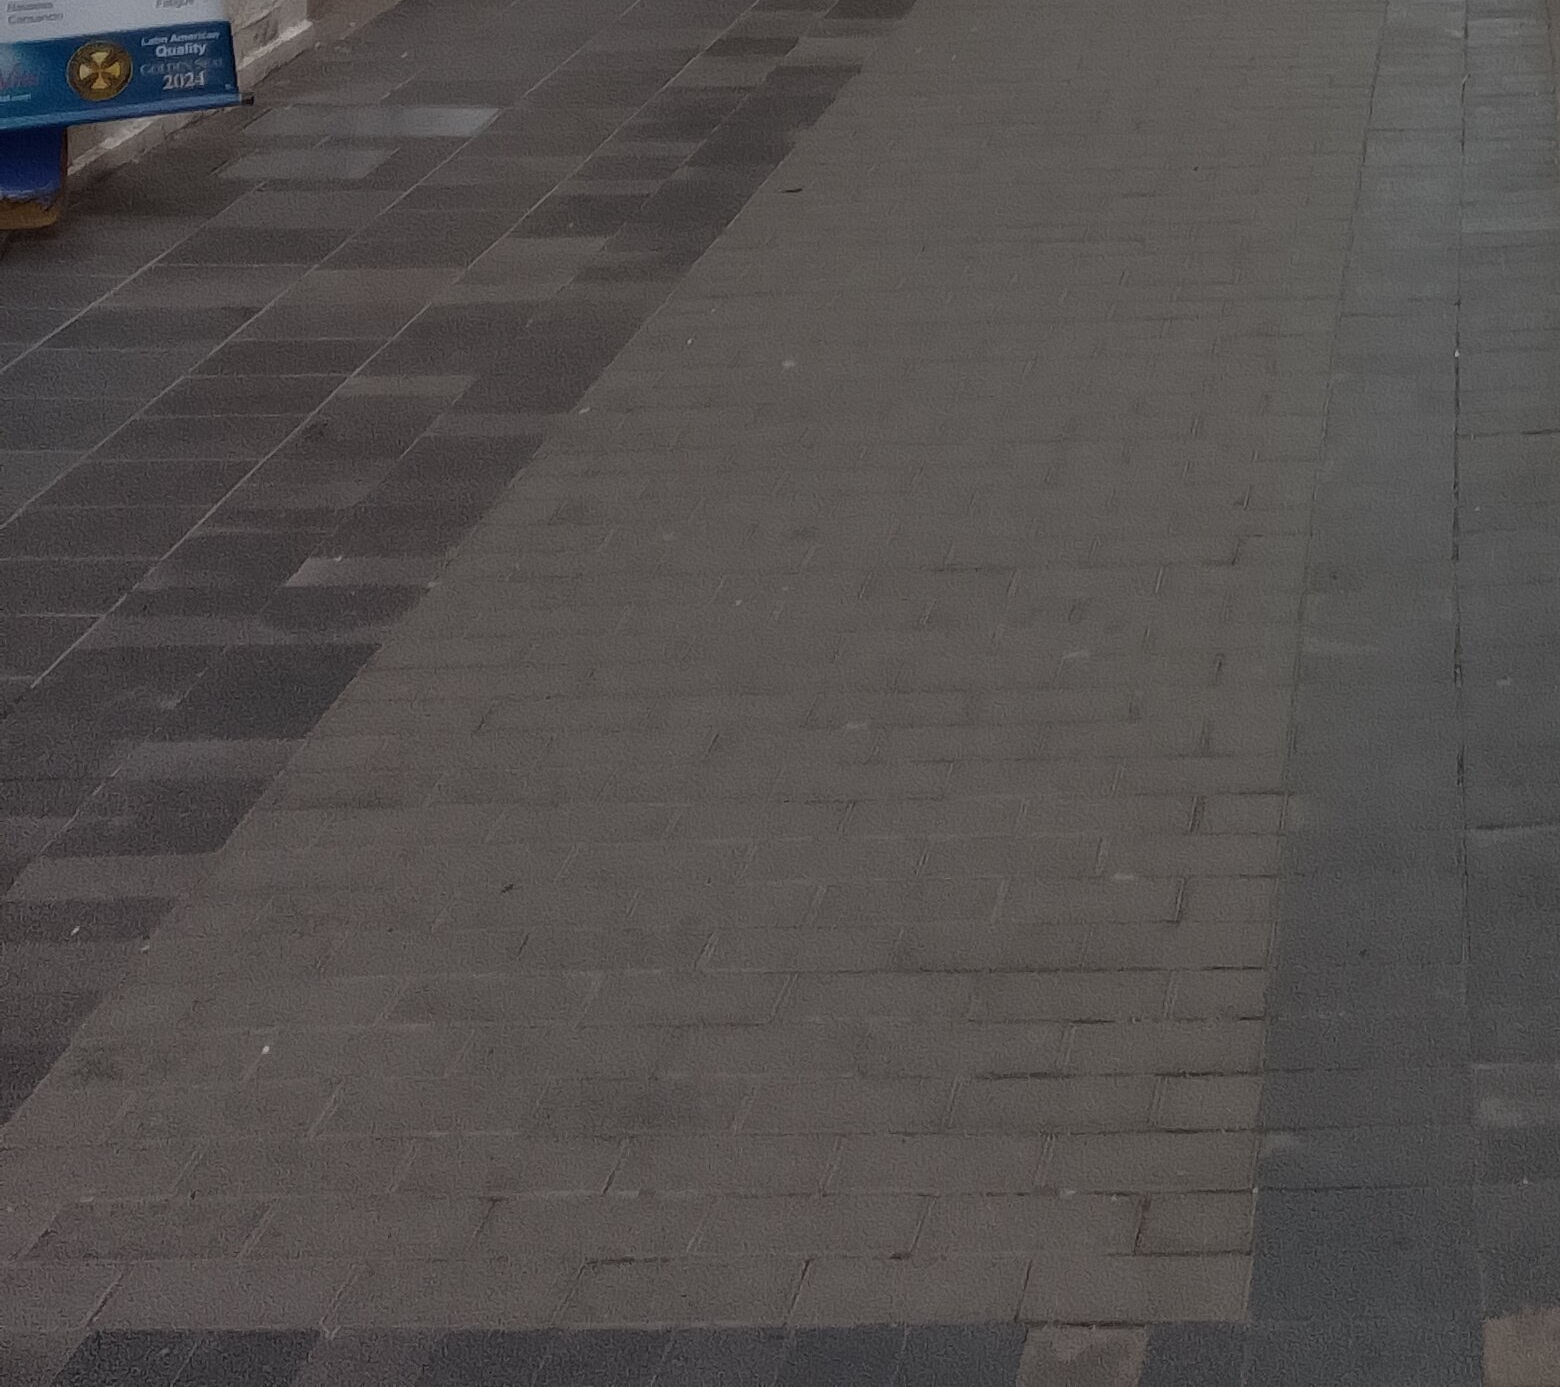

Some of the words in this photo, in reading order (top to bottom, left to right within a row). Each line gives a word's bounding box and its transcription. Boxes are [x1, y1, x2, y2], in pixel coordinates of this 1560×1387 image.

[141, 36, 168, 47] Latin
[169, 31, 220, 44] American
[155, 42, 207, 58] Quality
